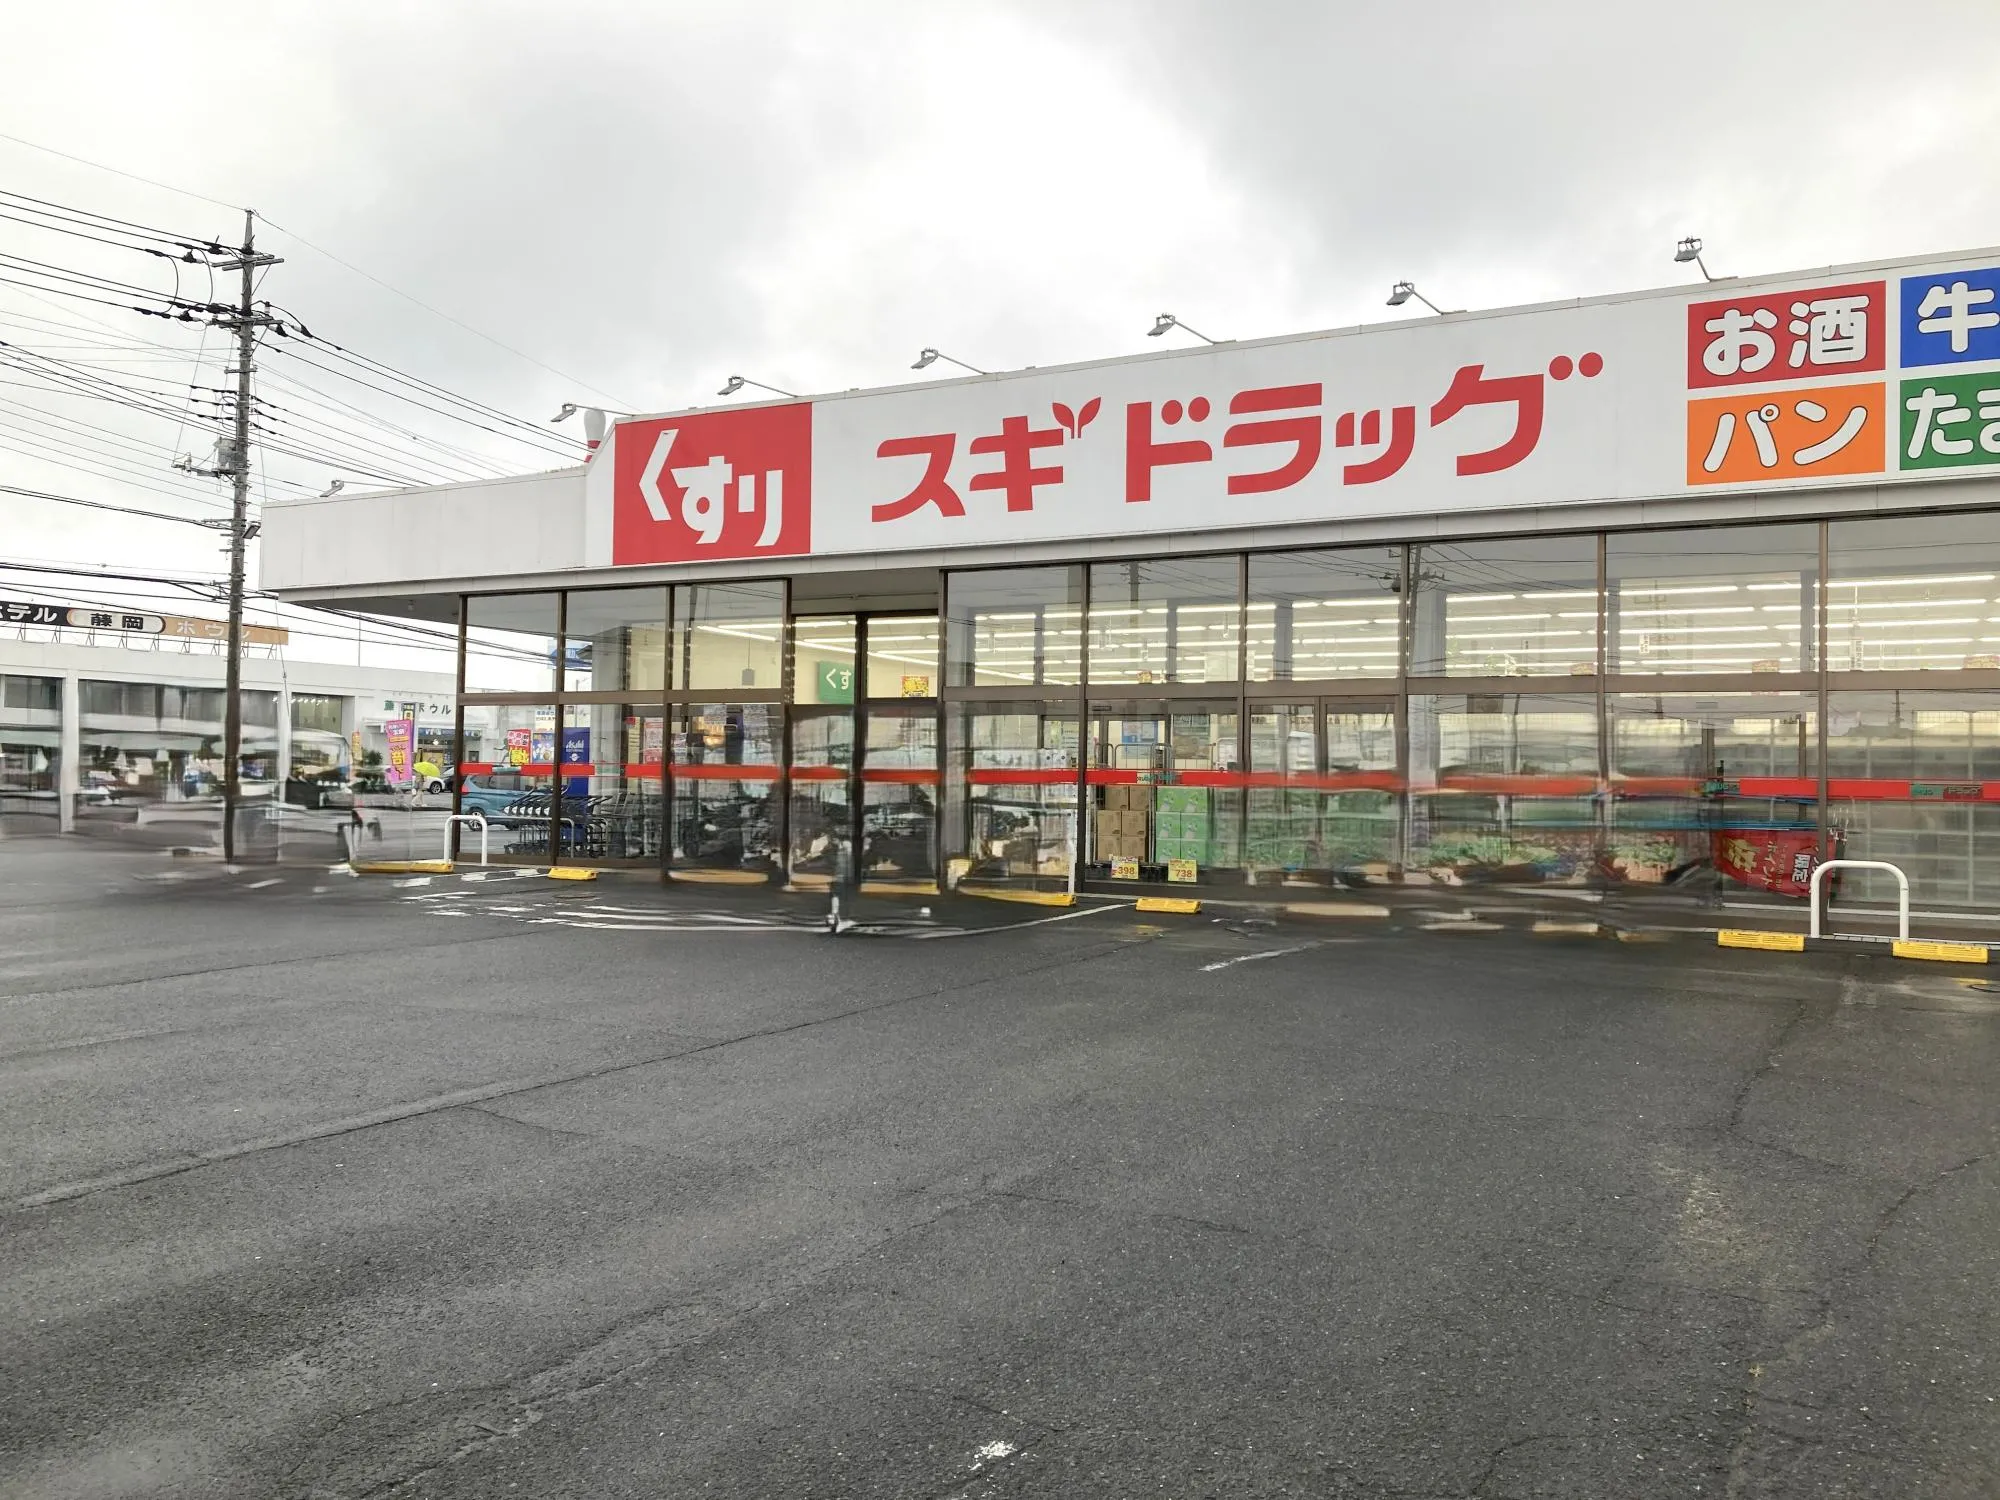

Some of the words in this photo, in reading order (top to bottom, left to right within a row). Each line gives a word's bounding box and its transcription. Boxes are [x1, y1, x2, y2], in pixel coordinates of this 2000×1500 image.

[1702, 295, 1870, 376] お酒
[1917, 281, 2000, 353] 牛
[872, 352, 1603, 522] スギドラッグ
[1703, 400, 1868, 473] パン
[638, 428, 783, 547] くすり
[0, 603, 57, 622] テル
[91, 613, 143, 630] 藤岡
[1118, 866, 1135, 875] 398
[1175, 869, 1193, 878] 738
